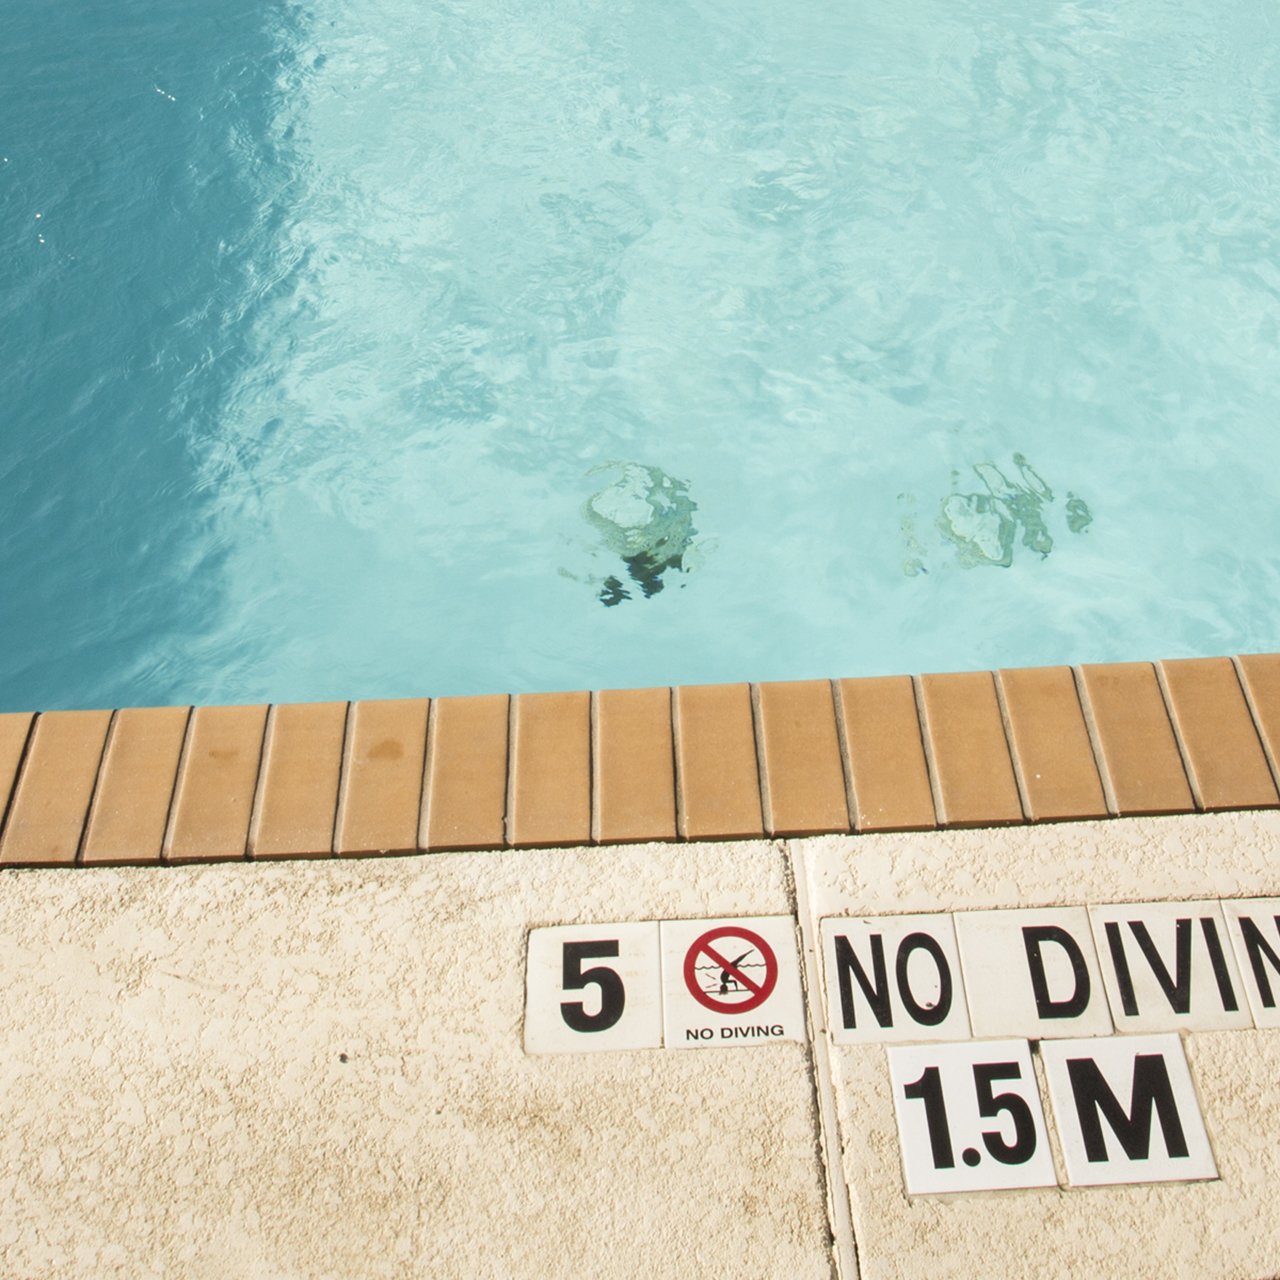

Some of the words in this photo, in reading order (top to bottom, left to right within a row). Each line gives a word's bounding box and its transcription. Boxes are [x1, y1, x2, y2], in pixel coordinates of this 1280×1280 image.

[560, 939, 626, 1033] 5
[834, 932, 953, 1029] NO
[685, 1027, 714, 1041] NO
[720, 1024, 785, 1039] DIVING
[903, 1061, 1037, 1170] 1.5
[1066, 1053, 1190, 1163] M
